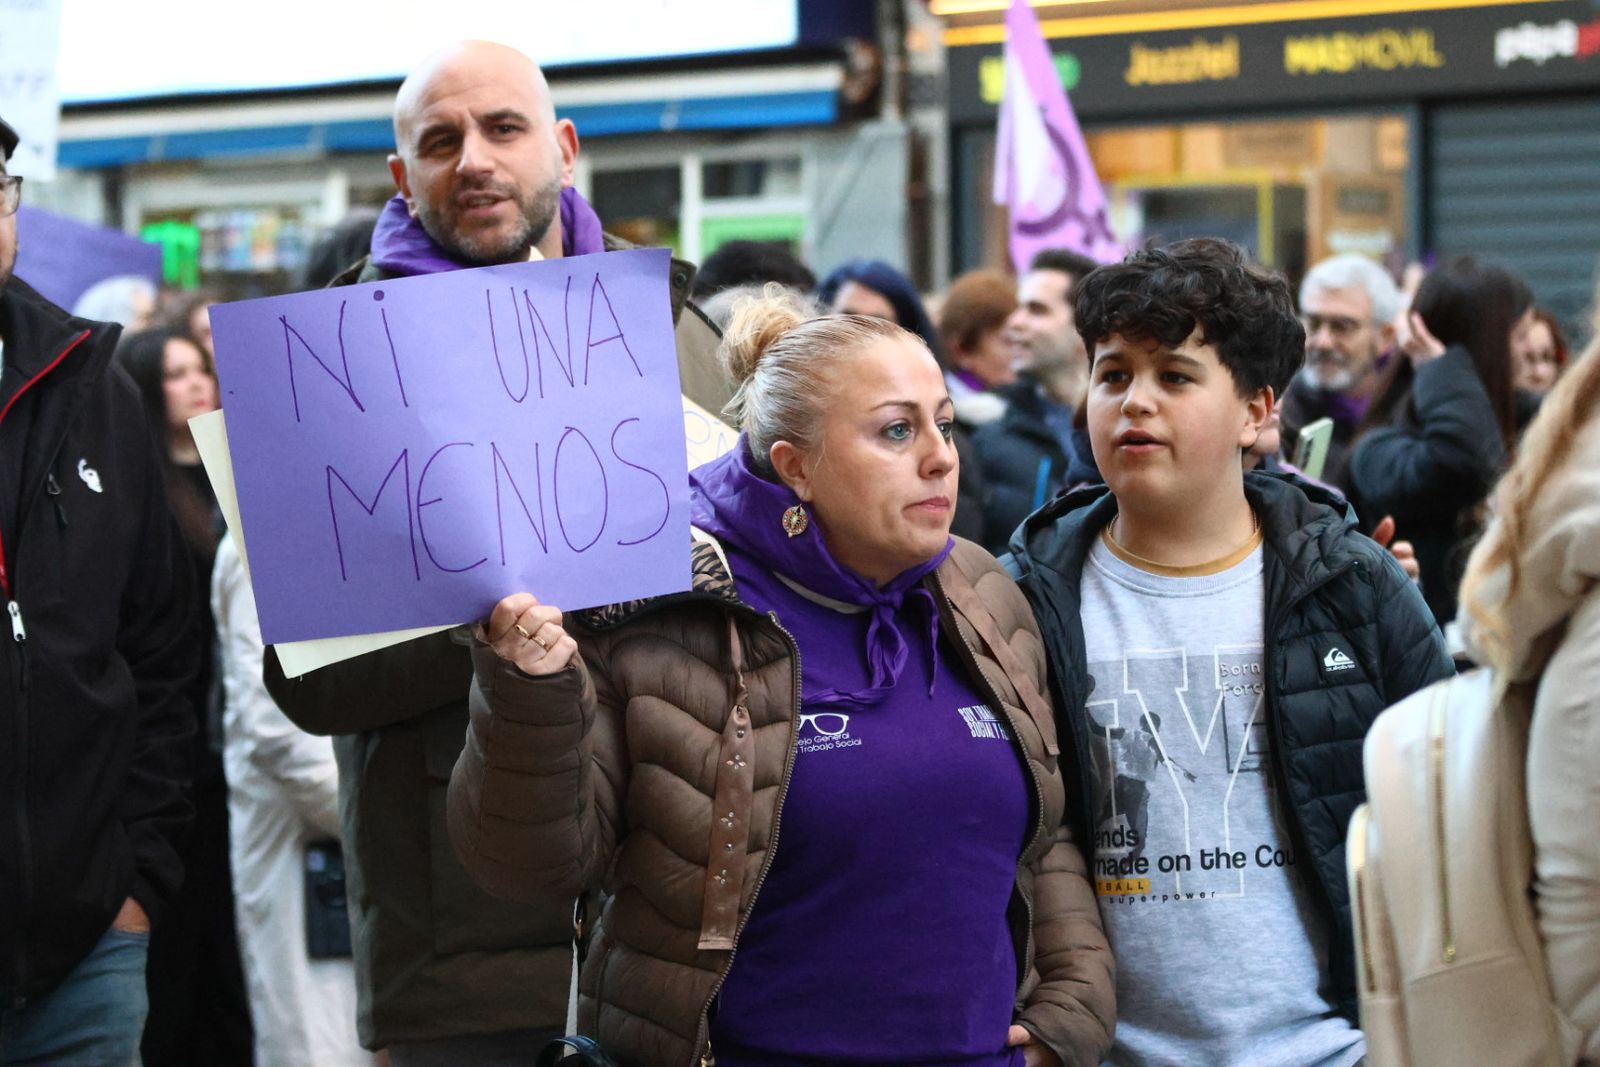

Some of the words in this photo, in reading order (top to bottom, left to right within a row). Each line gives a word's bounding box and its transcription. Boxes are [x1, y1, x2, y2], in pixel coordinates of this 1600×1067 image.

[486, 272, 643, 403] UNA
[326, 416, 670, 581] MENOS
[1219, 662, 1261, 678] Born
[1222, 681, 1266, 698] Forc
[797, 738, 813, 747] ejo
[813, 731, 850, 744] General
[800, 741, 834, 754] Trabajo
[835, 737, 862, 748] Social
[1094, 823, 1141, 848] ends
[1157, 853, 1192, 873] on
[1200, 847, 1247, 871] the
[1254, 844, 1297, 869] Cou
[1109, 889, 1216, 905] superpower
